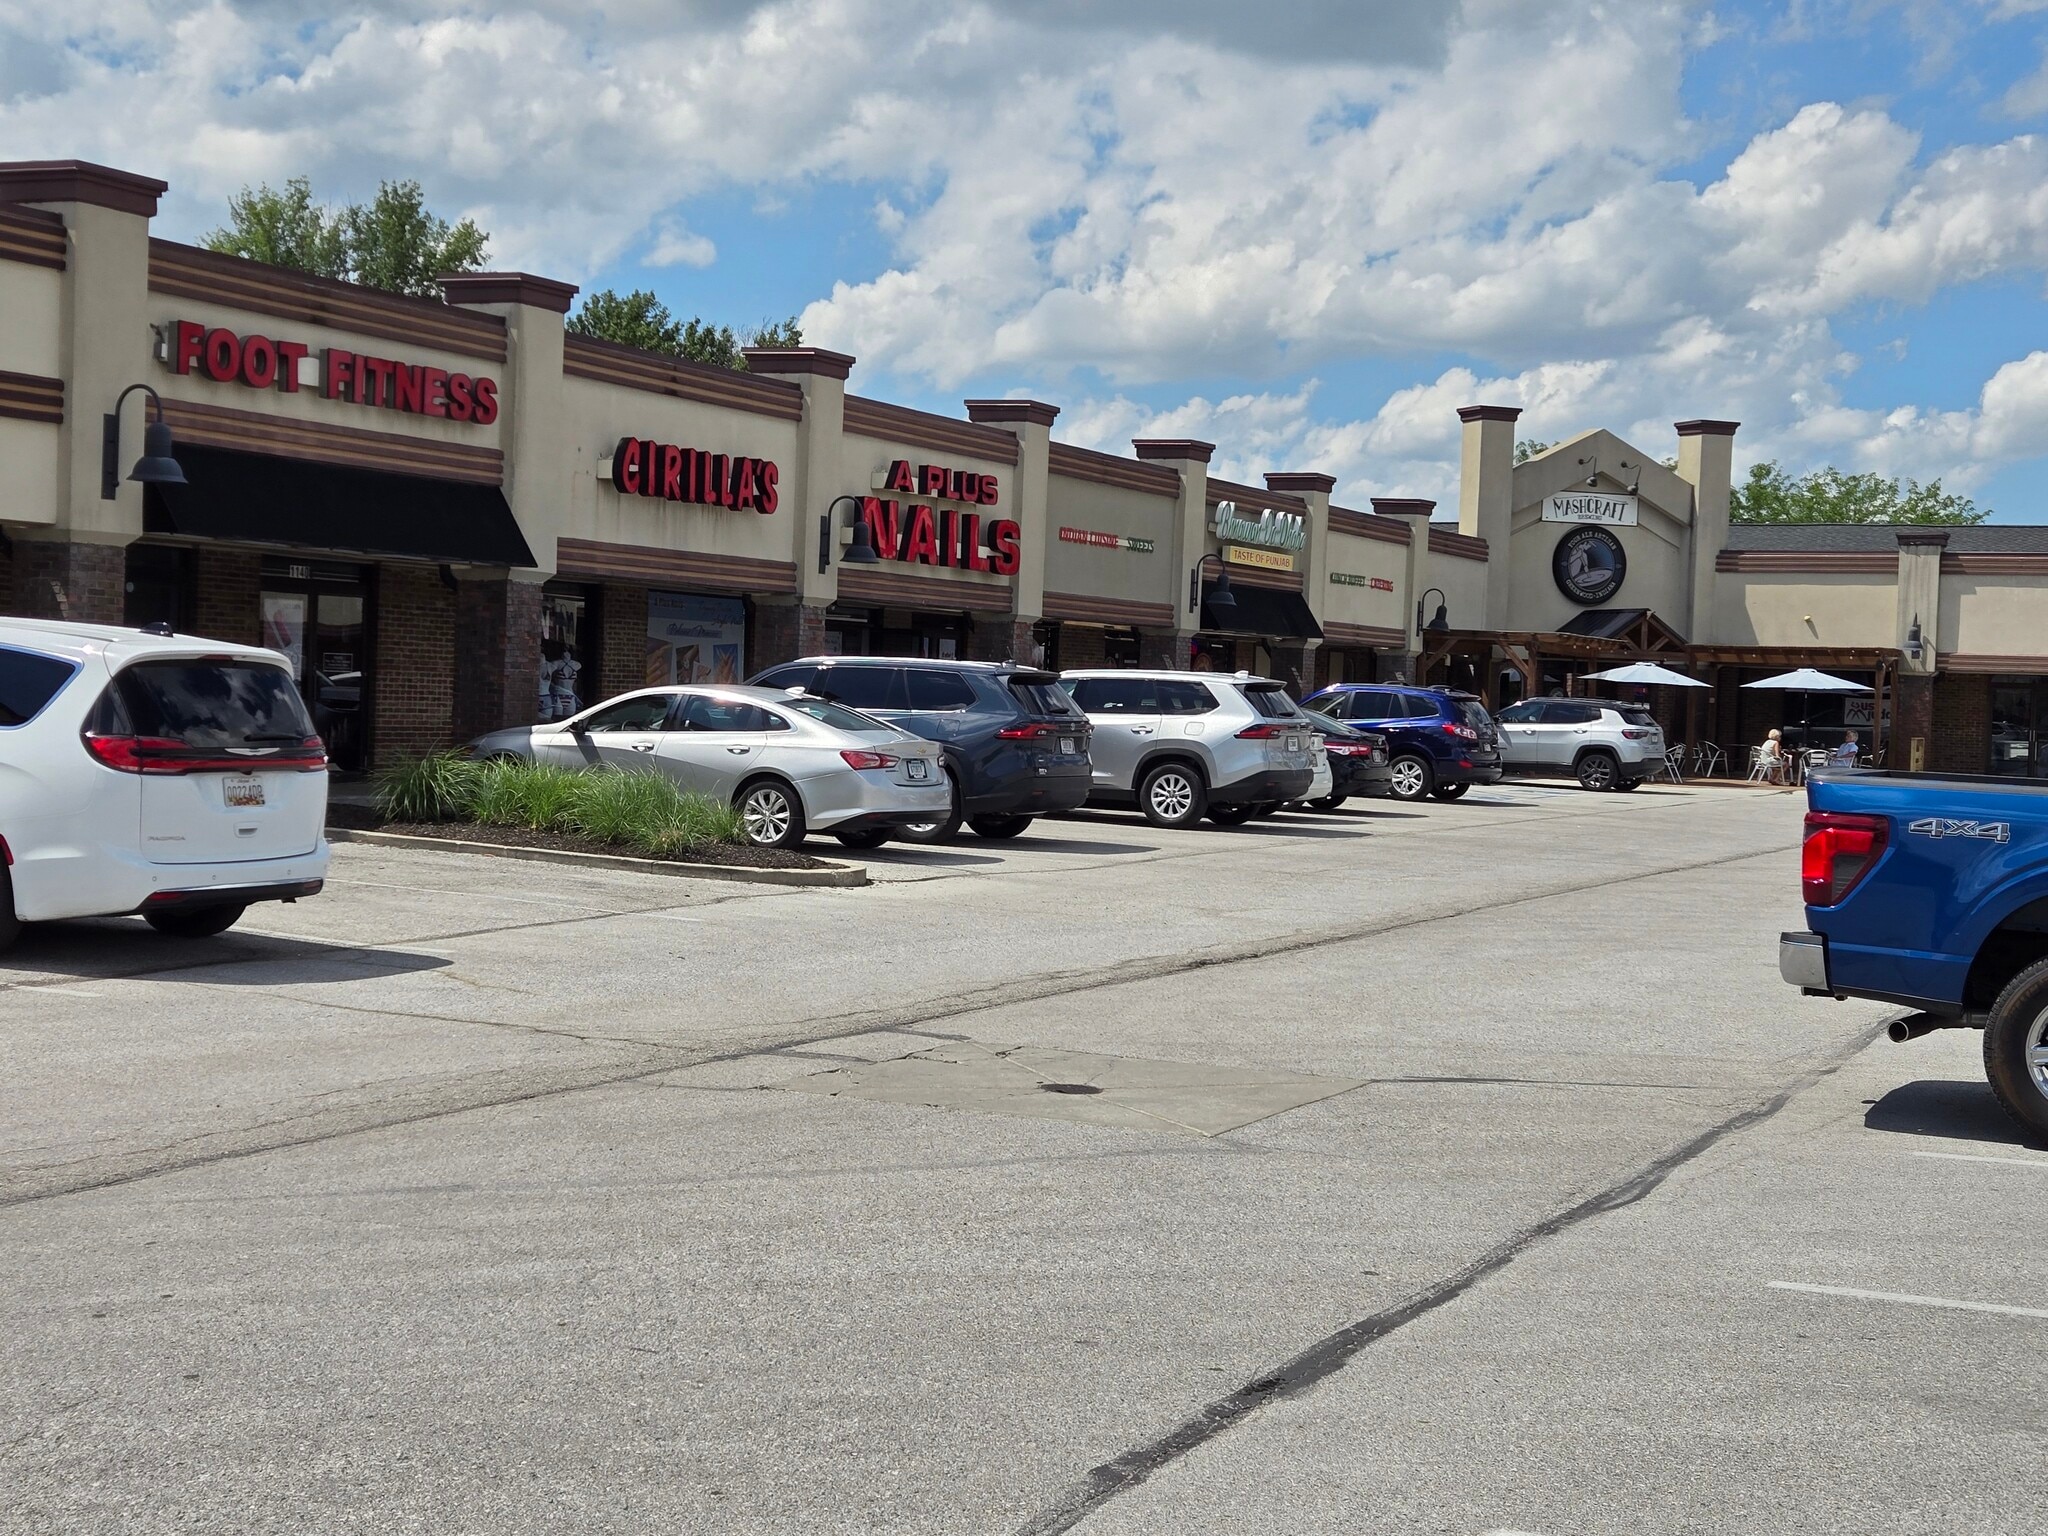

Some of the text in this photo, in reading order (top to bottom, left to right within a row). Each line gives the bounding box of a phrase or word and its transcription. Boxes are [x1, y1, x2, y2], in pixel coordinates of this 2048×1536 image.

[170, 320, 498, 425] FOOT FITNESS
[613, 437, 778, 514] CIRILLA'S
[885, 460, 998, 505] A PLUS
[855, 496, 1020, 576] NAILS
[1553, 498, 1628, 521] MASHCRAFT
[1233, 549, 1291, 567] TASTE OF PUNJAB
